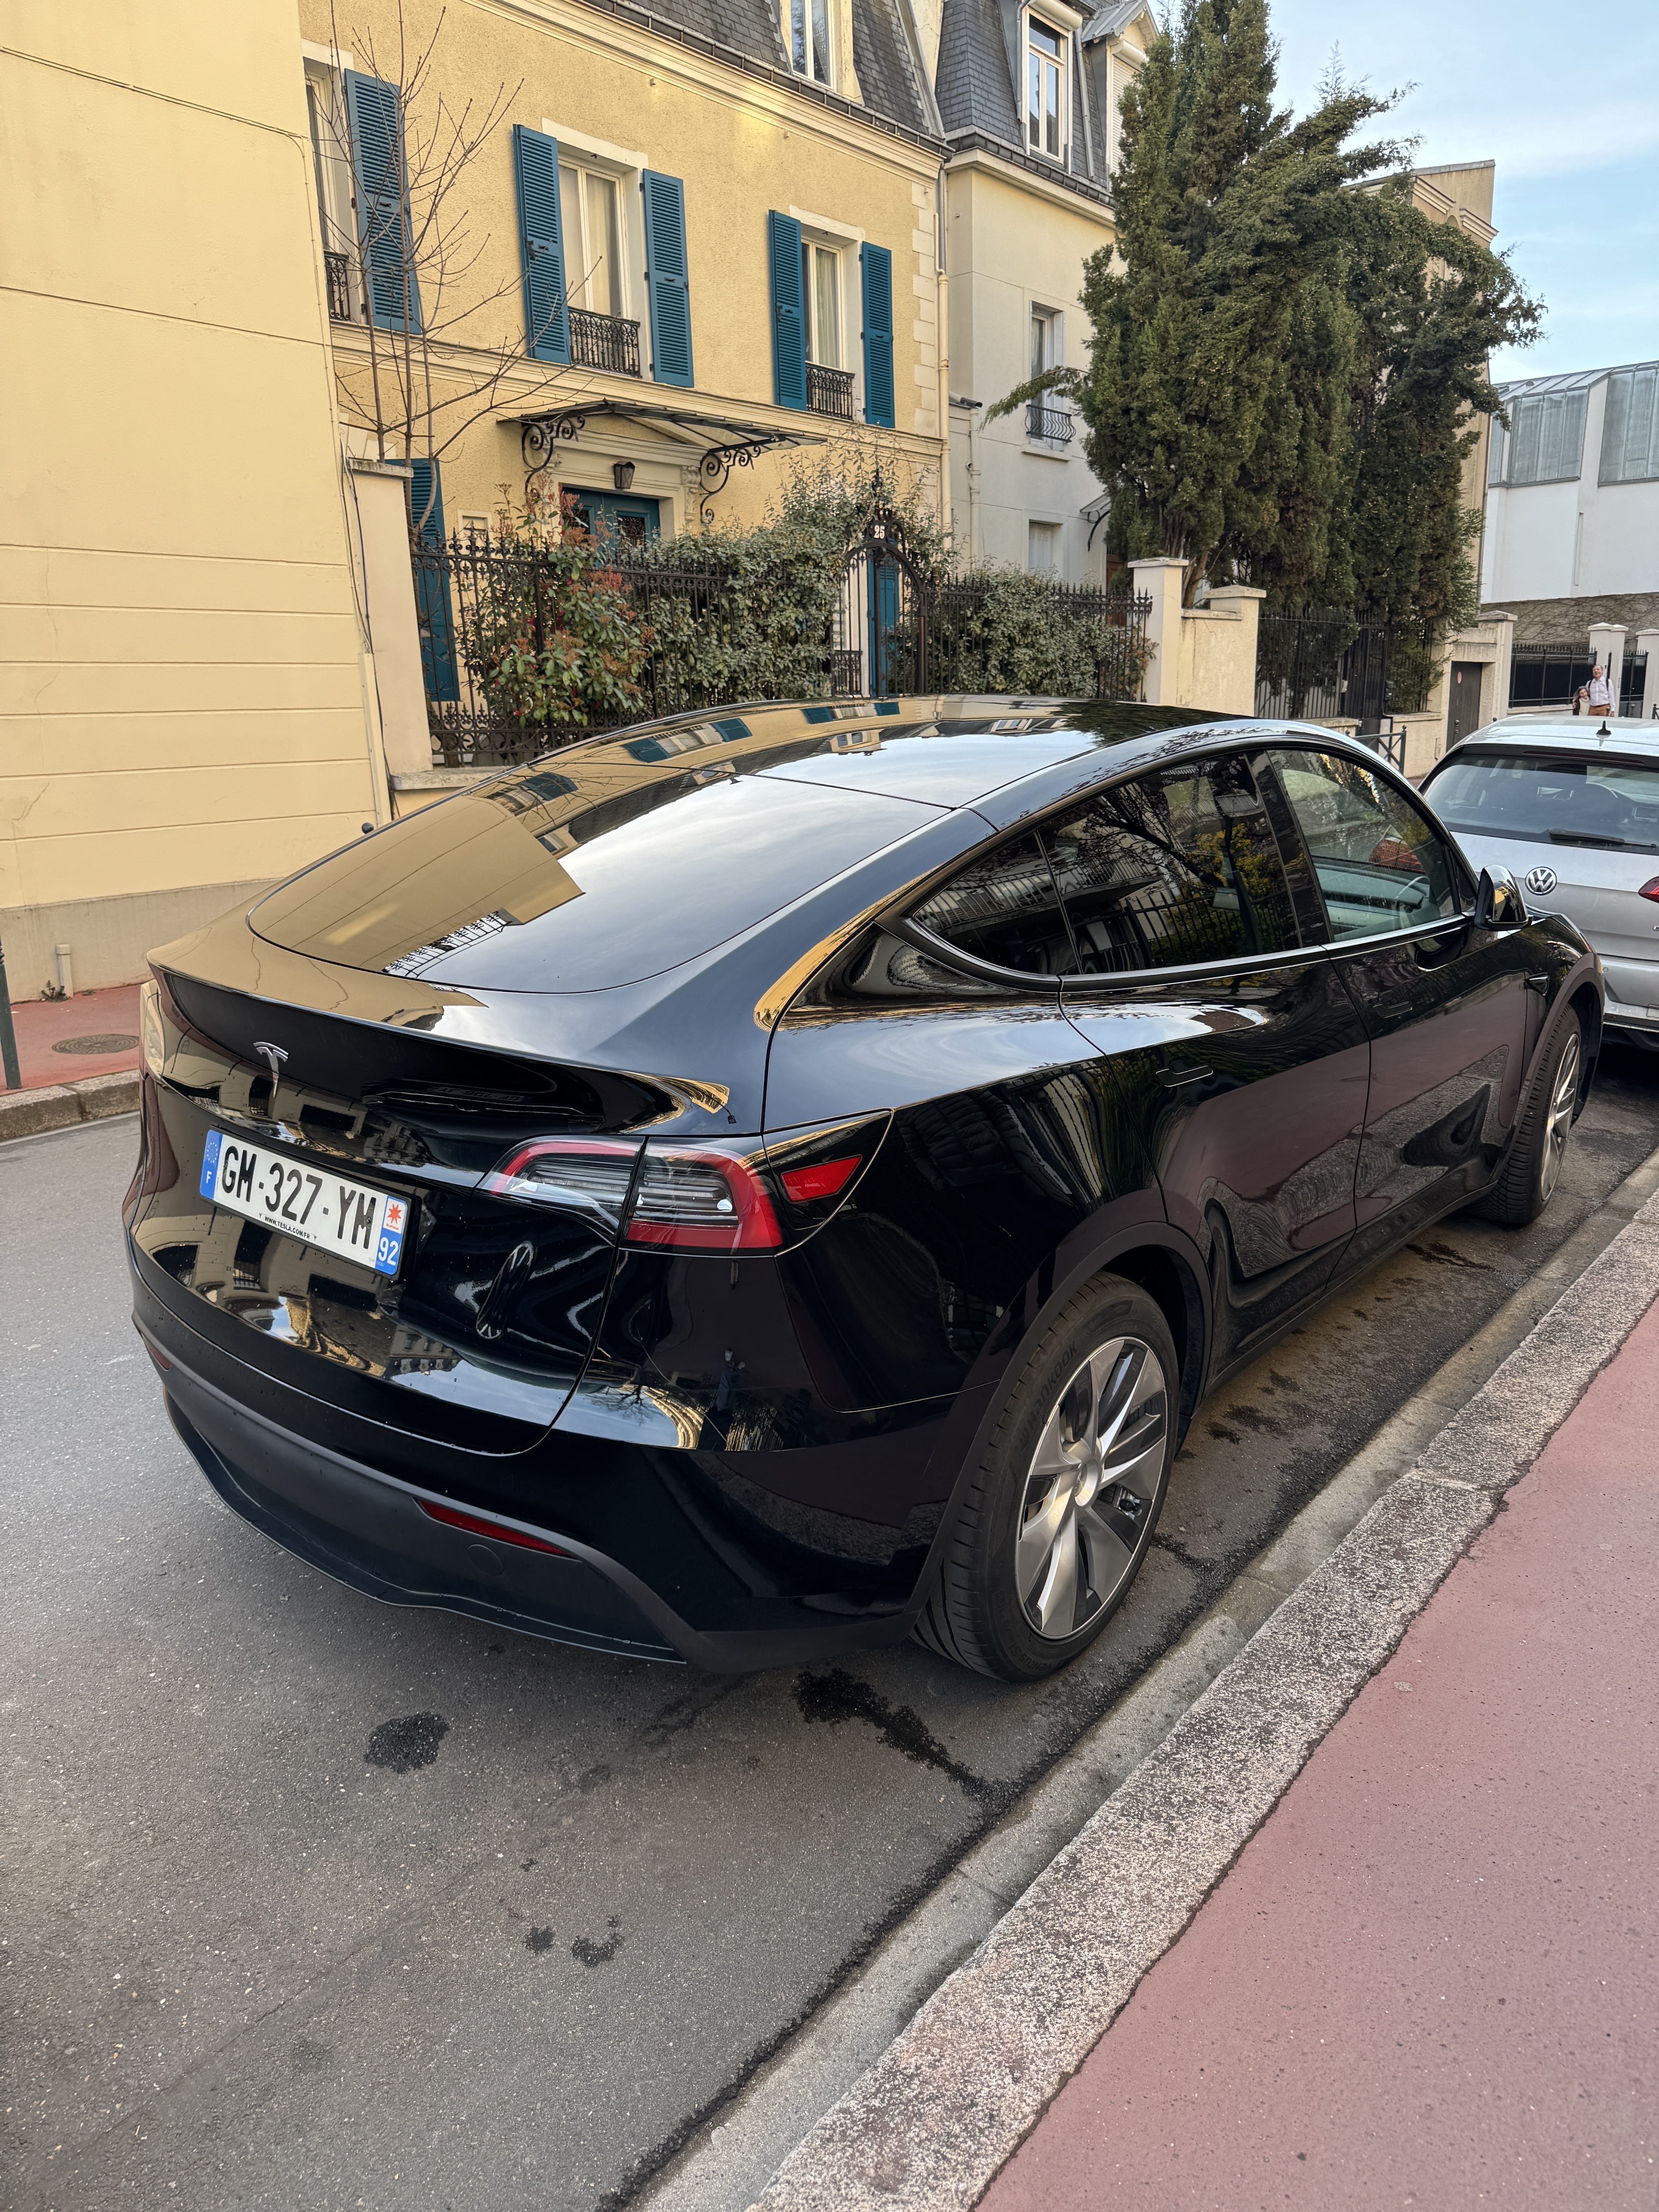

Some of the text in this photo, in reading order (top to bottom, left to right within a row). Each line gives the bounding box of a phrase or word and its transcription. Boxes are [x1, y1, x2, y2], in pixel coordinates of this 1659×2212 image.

[874, 525, 885, 539] 25
[206, 1171, 212, 1183] F
[222, 1146, 376, 1249] GM-327-YM
[378, 1237, 398, 1266] 92
